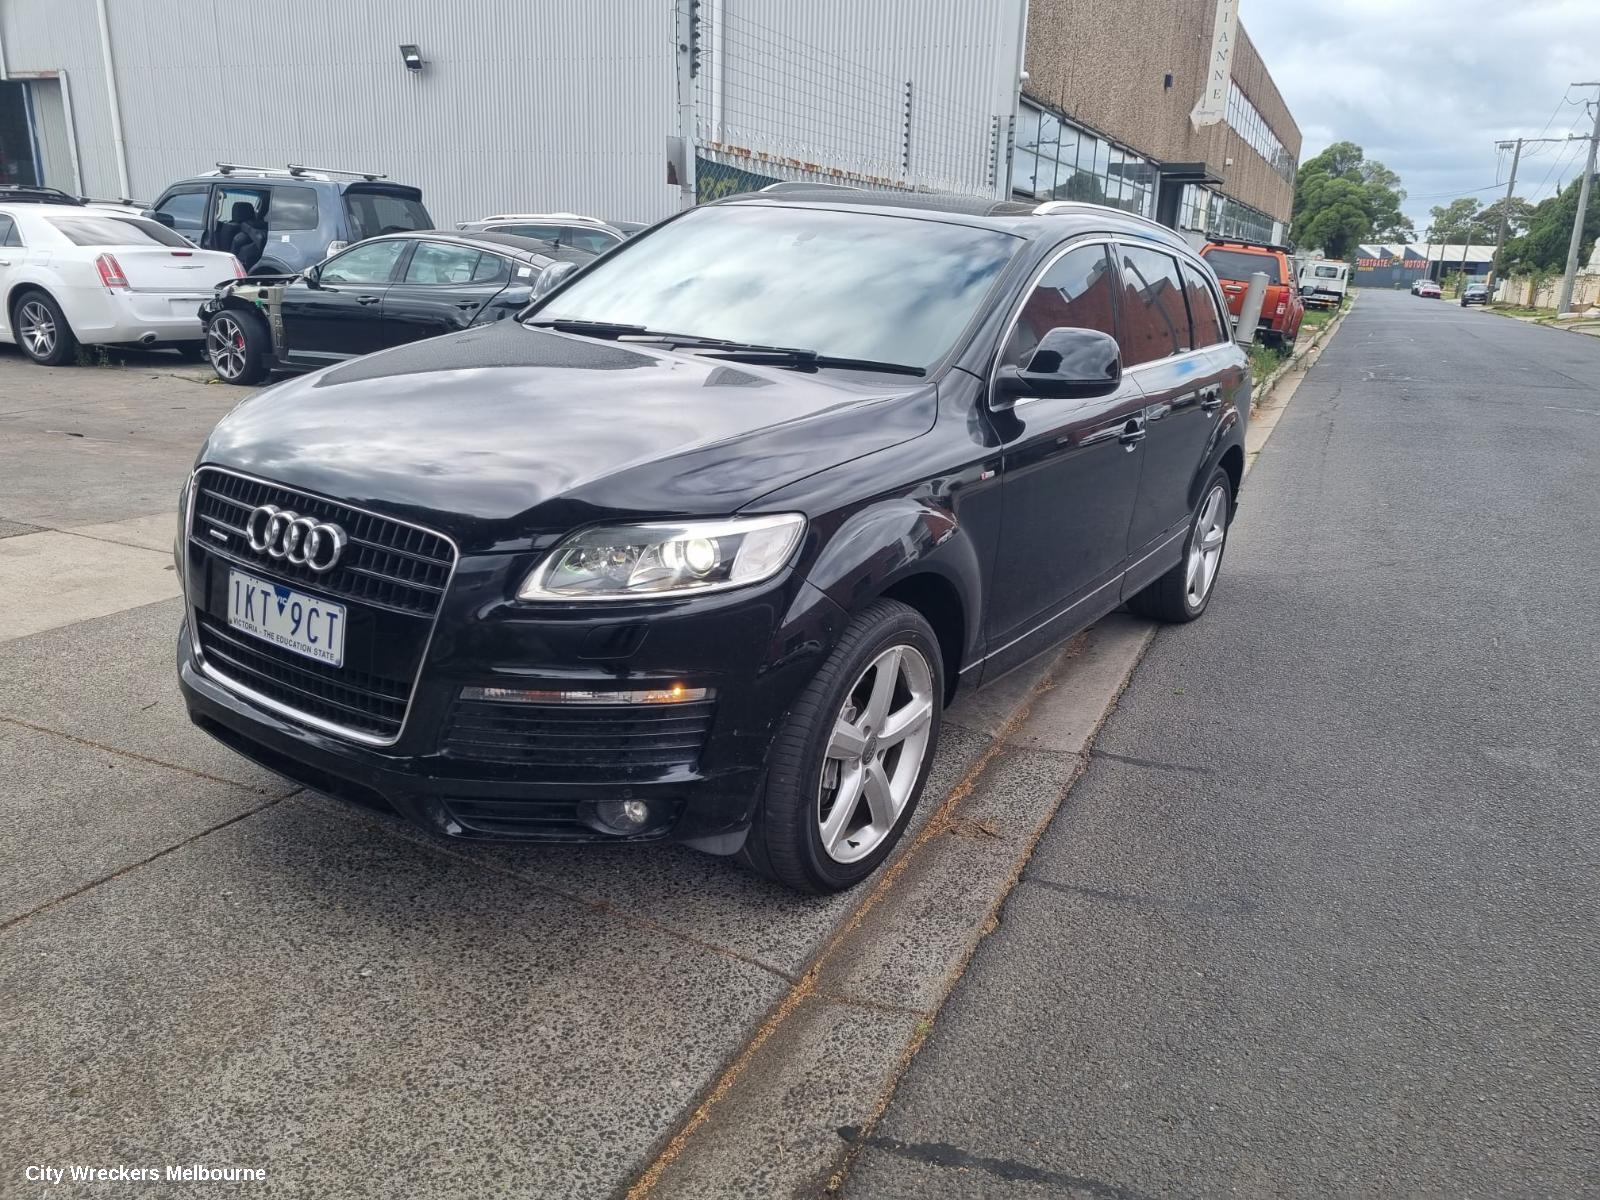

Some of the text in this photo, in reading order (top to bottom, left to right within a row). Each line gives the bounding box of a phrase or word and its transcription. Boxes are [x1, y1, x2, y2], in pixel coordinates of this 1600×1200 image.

[1213, 0, 1232, 99] IANNE
[233, 617, 258, 634] VICTORIA
[263, 629, 275, 640] THE
[276, 634, 312, 653] EDUCATION
[313, 647, 335, 661] STATE
[236, 580, 338, 650] 1KT 9CT
